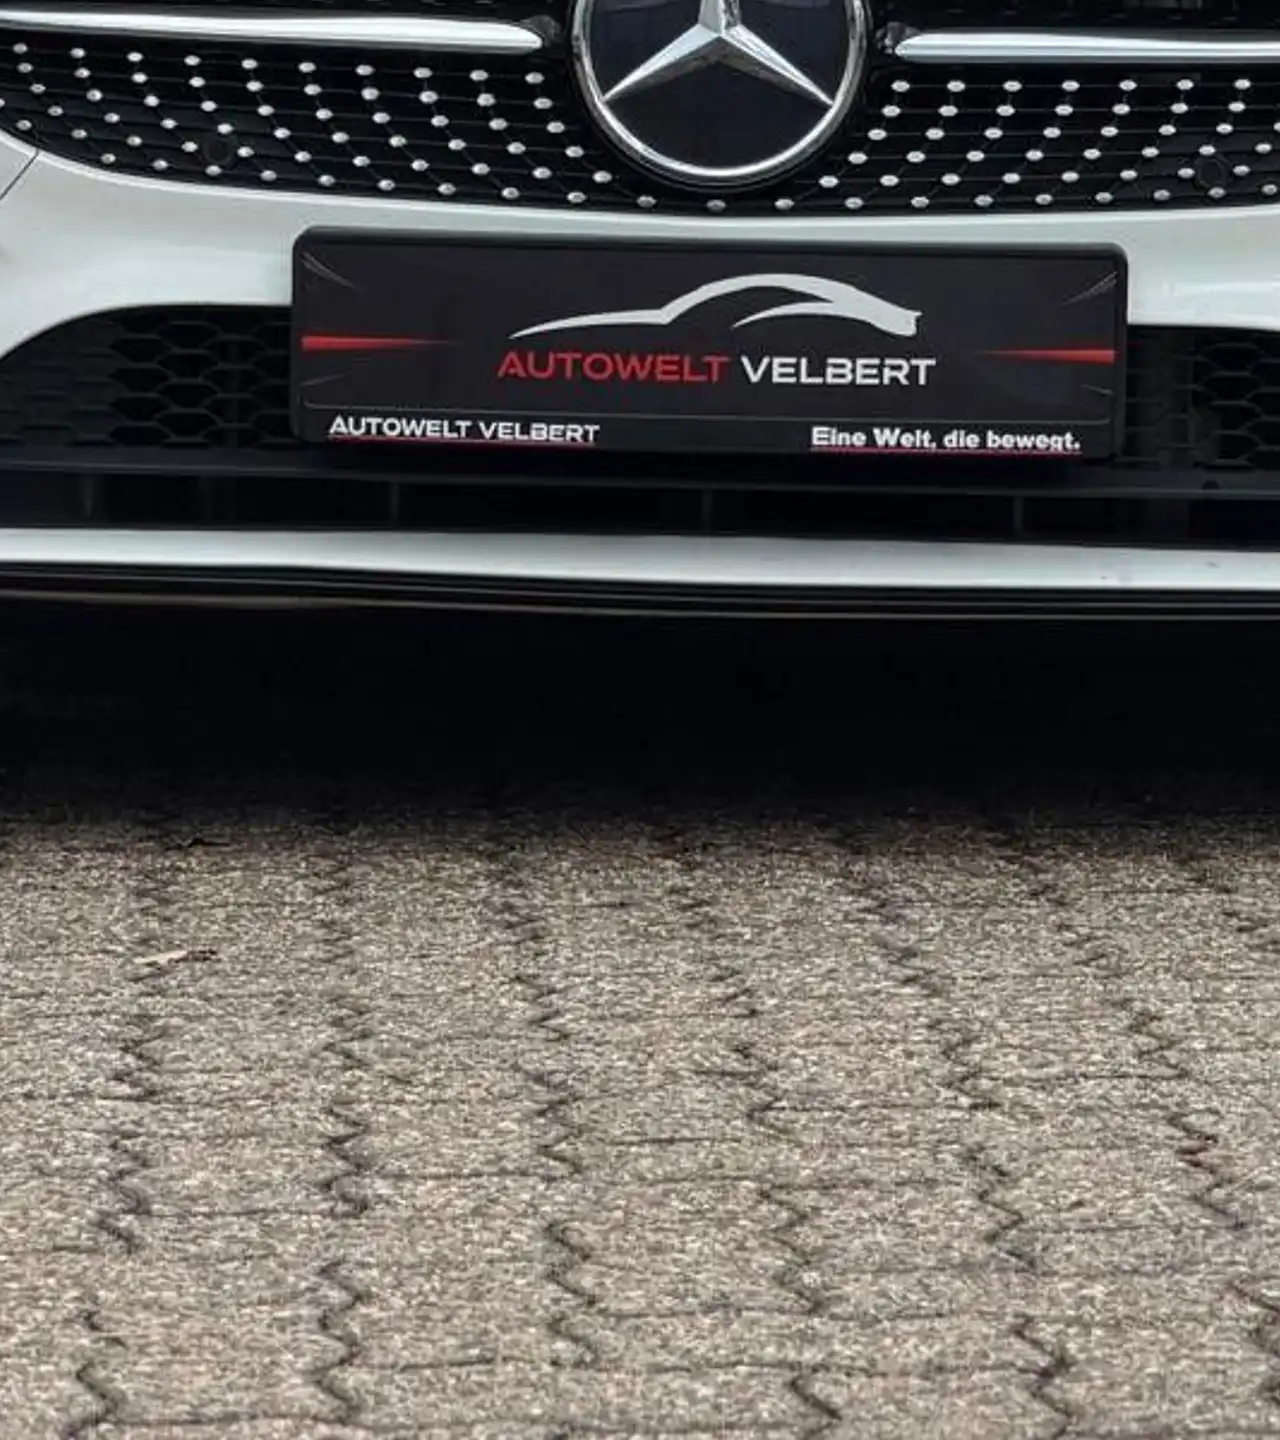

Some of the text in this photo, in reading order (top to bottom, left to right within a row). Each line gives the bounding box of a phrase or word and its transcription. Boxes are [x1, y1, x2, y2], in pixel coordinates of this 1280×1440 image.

[498, 350, 937, 385] AUTOWELT VELBERT
[328, 415, 601, 443] AUTOWELT VELBERT
[811, 426, 1081, 454] Eine Welt, die bewegt.
